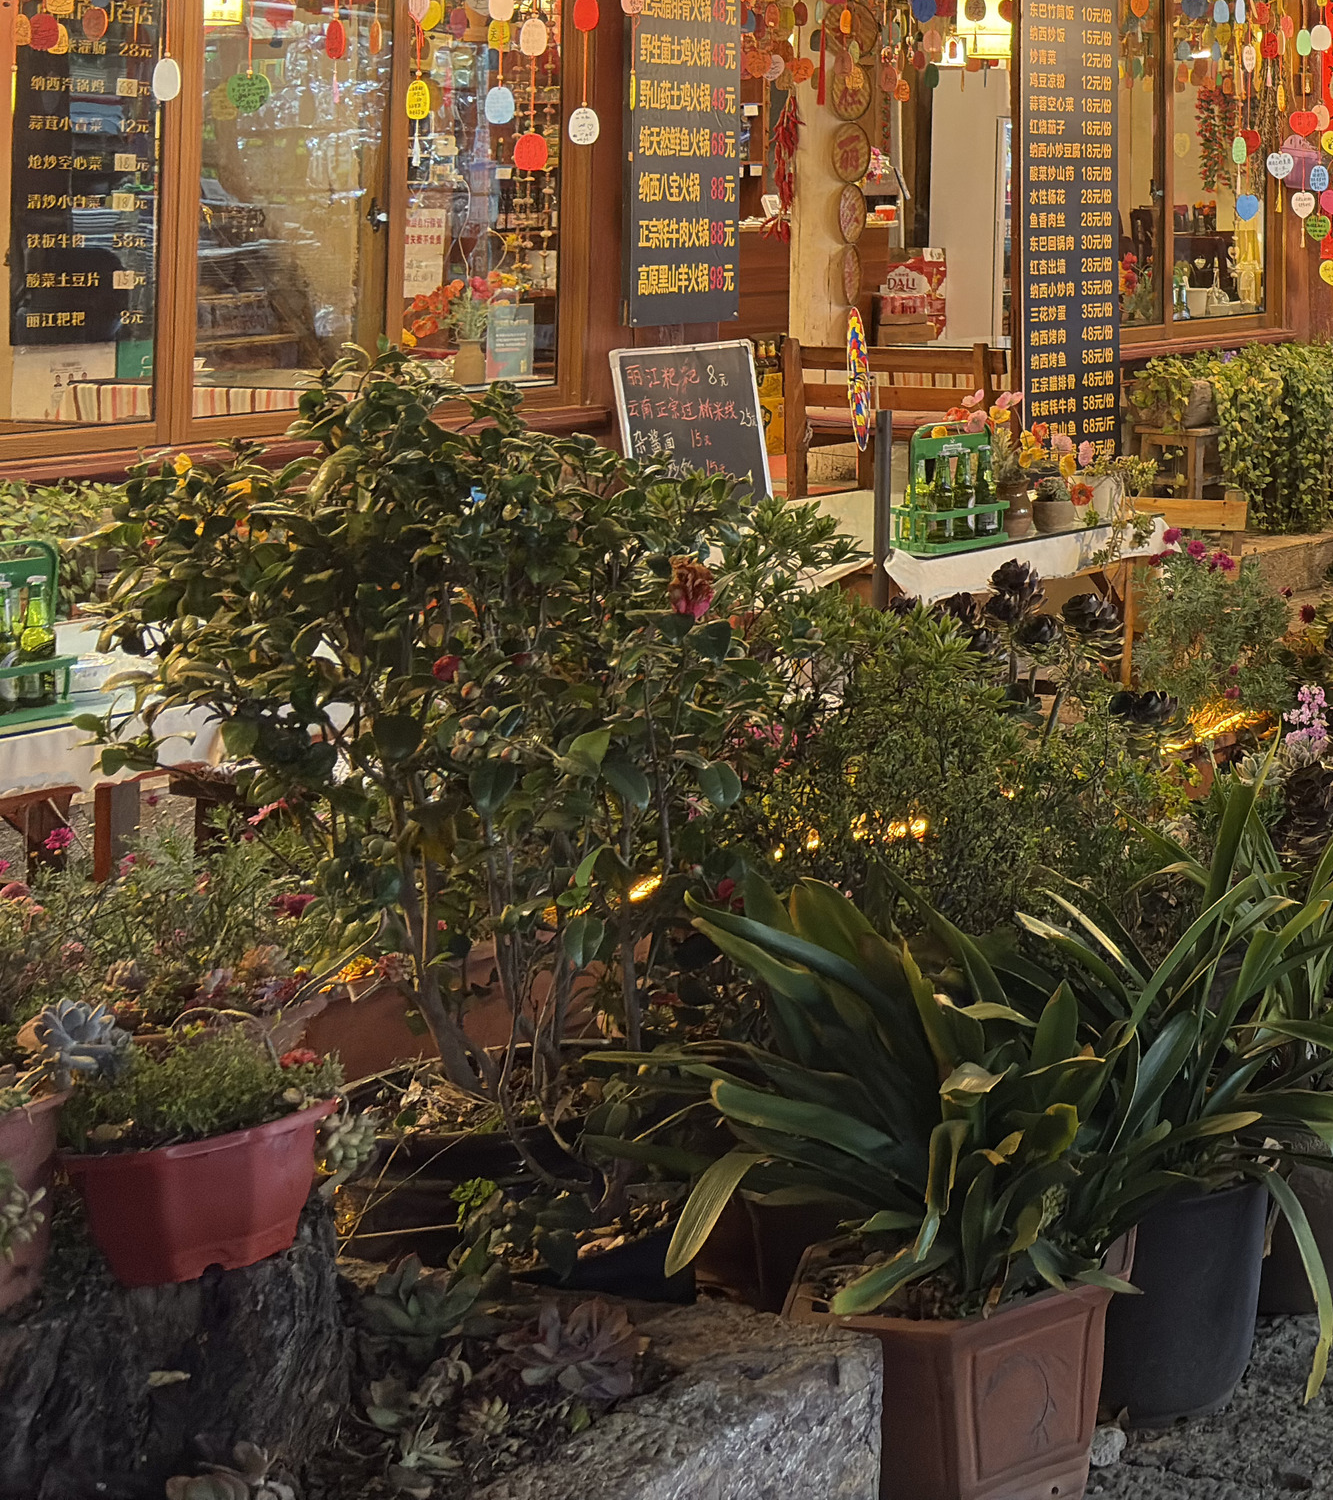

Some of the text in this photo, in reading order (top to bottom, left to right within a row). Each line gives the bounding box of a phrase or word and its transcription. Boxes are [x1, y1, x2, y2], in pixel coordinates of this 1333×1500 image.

[1030, 2, 1112, 24] 东巴竹筒饭 10元/份
[1030, 25, 1112, 46] 纳西炒饭 15元/份
[119, 42, 152, 58] 28元
[640, 34, 737, 69] 野生菌土鸡火锅 48元
[1029, 48, 1112, 68] 炒青菜 12元/份
[30, 75, 105, 94] 纳西汽锅鸡
[1029, 72, 1112, 91] 鸡豆凉粉 12元/份
[639, 79, 736, 114] 野山药土鸡火锅 48元
[1081, 97, 1112, 114] 18元/份
[119, 119, 149, 133] 12元
[1029, 119, 1112, 136] 红烧茄子 18元/份
[639, 126, 735, 158] 纯天然鲜鱼火锅 68元
[1029, 142, 1112, 159] 纳西小炒豆腐 18元/份
[1029, 166, 1112, 182] 酸菜炒山药 18元/份
[639, 172, 735, 203] 纳西八宝火锅 88元
[1081, 189, 1112, 204] 28元/份
[27, 194, 101, 210] 清炒小白菜
[1029, 212, 1112, 228] 鱼香肉丝 28元/份
[27, 233, 146, 250] 铁板牛肉 58元
[710, 220, 735, 247] 88元
[1029, 235, 1112, 252] 东巴回锅肉 30元/份
[1029, 257, 1112, 275] 红杏出墙 28元/份
[26, 273, 100, 289] 酸菜土豆片
[638, 263, 734, 296] 高原黑山羊火锅 98元
[888, 277, 917, 291] DALI
[1030, 279, 1112, 299] 纳西小炒肉 35元/份
[26, 310, 144, 328] 丽江粑粑 8元
[1030, 302, 1113, 322] 三花炒蛋 35元/份
[1030, 325, 1113, 346] 纳西烤肉 48元/份
[1030, 347, 1113, 370] 纳西烤鱼 58元/份
[1031, 370, 1114, 393] 正宗腊排骨 48元/份
[1082, 393, 1114, 410] 58元/份
[1083, 416, 1114, 434] 68元/斤
